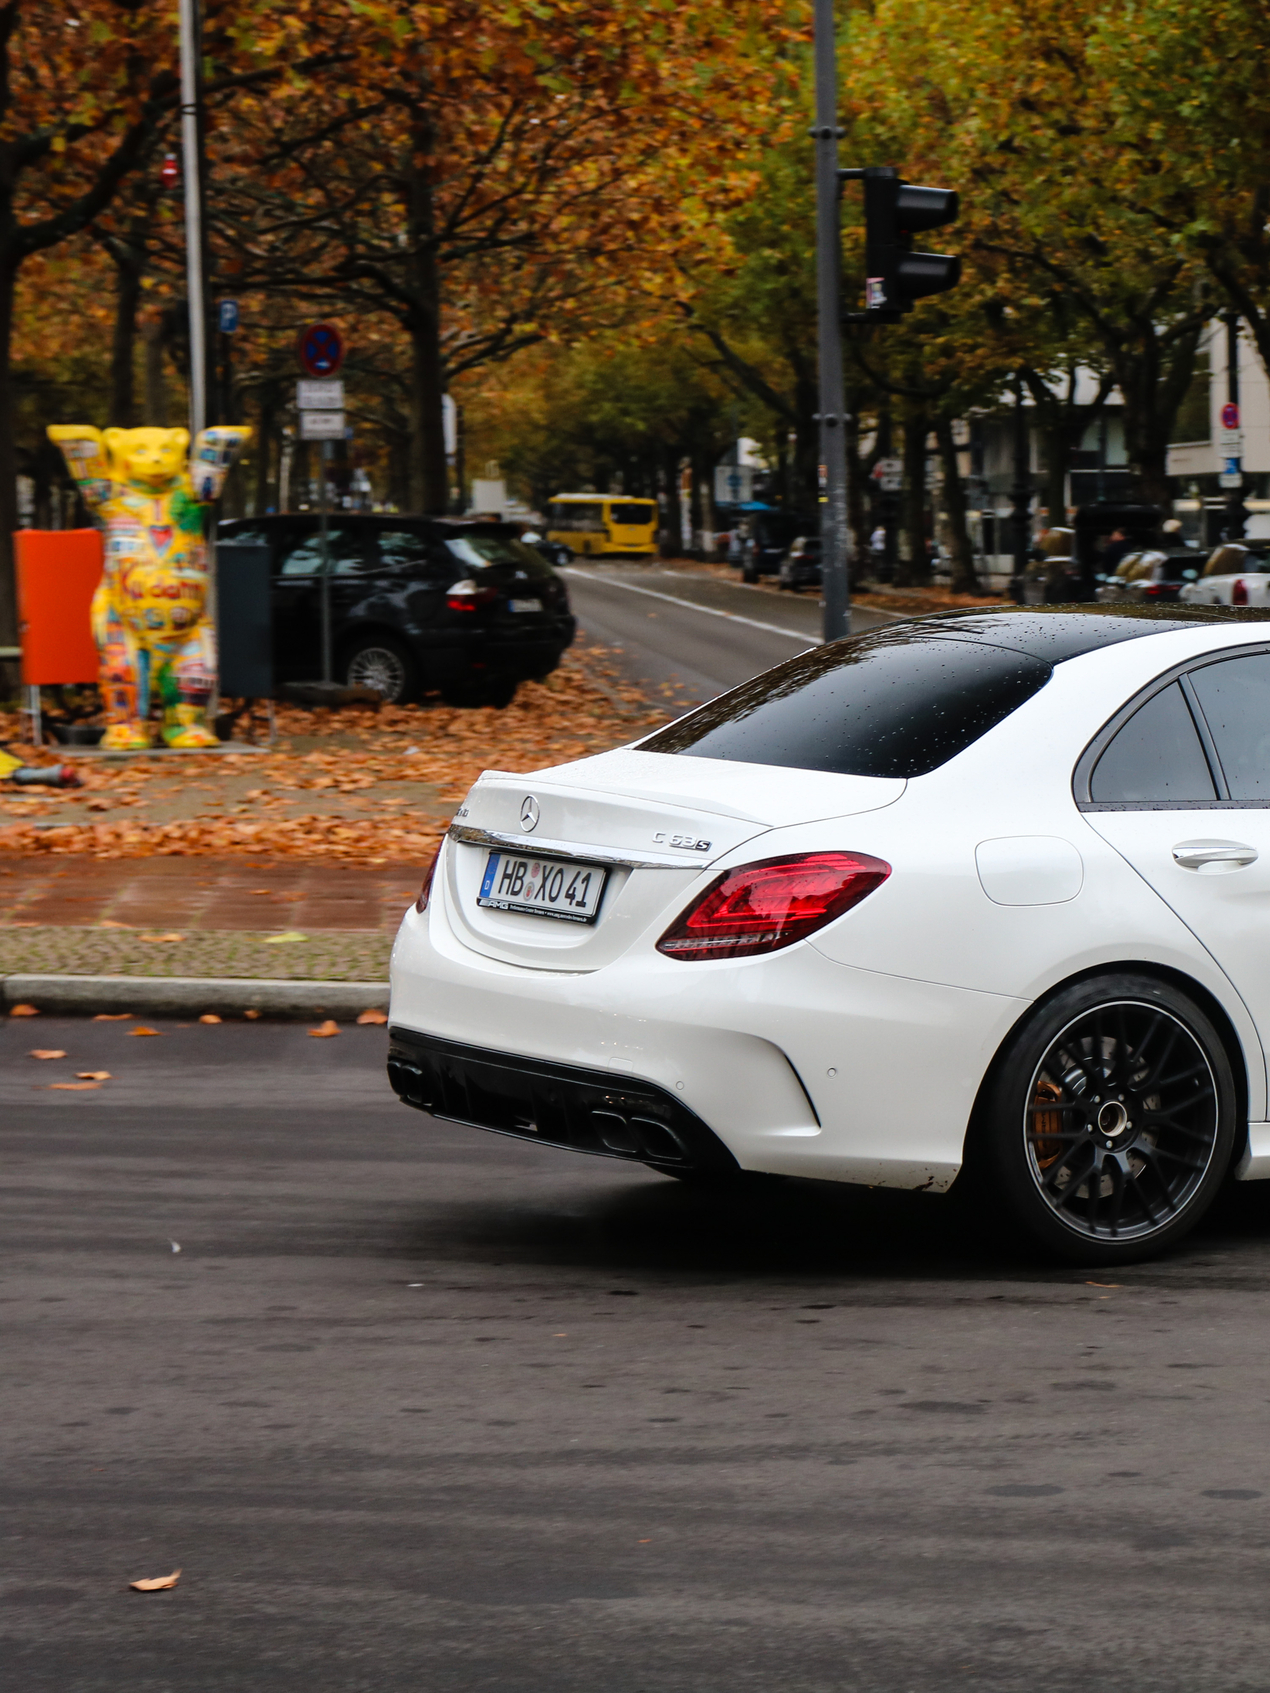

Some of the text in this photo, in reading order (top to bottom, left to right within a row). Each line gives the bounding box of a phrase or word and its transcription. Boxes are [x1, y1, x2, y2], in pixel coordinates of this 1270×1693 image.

[498, 860, 592, 908] HB XO 41
